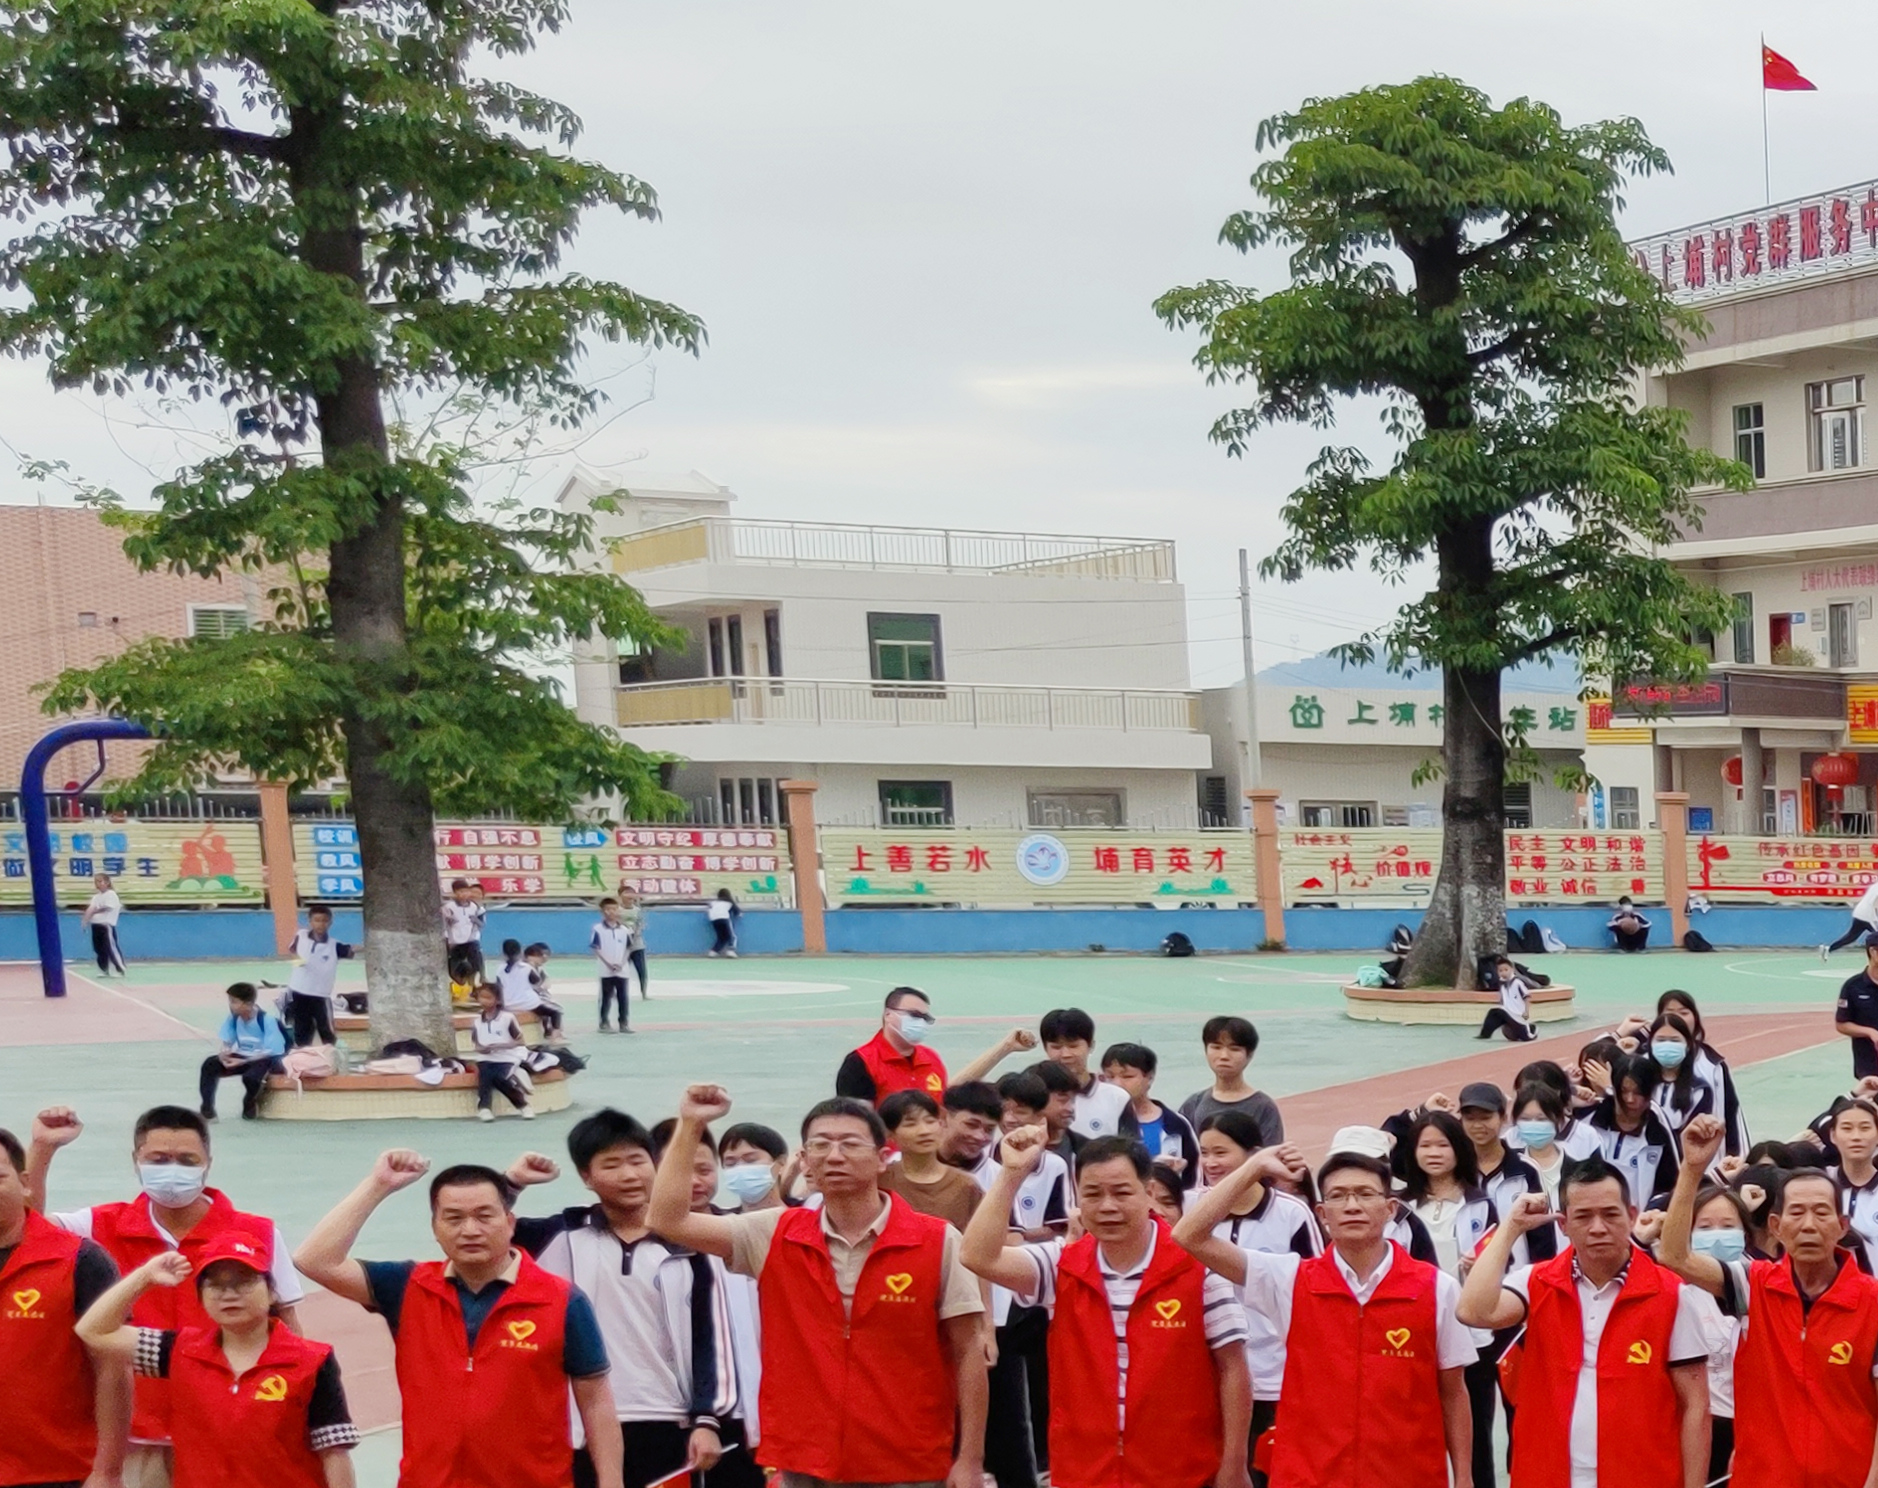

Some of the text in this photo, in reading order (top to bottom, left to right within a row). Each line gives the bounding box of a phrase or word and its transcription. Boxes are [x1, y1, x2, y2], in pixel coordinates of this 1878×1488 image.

[463, 829, 538, 846] 自强不息
[620, 831, 774, 847] 文明守纪 厚德奉献
[1294, 833, 1353, 847] 社会主义
[1509, 835, 1647, 852] 民主 文明 和谐
[1758, 843, 1861, 858] 传承红色基因
[3, 857, 160, 877] 做明学生
[465, 854, 540, 870] 博学创新
[622, 855, 776, 871] 立志勤奋 博学创新
[849, 845, 1228, 874] 上善若水 埔育英才
[1508, 855, 1647, 872] 平等 公正 法治
[1376, 860, 1433, 877] 价值观
[321, 877, 358, 893] 学风
[1509, 878, 1548, 894] 敬业
[1560, 877, 1598, 894] 诚信
